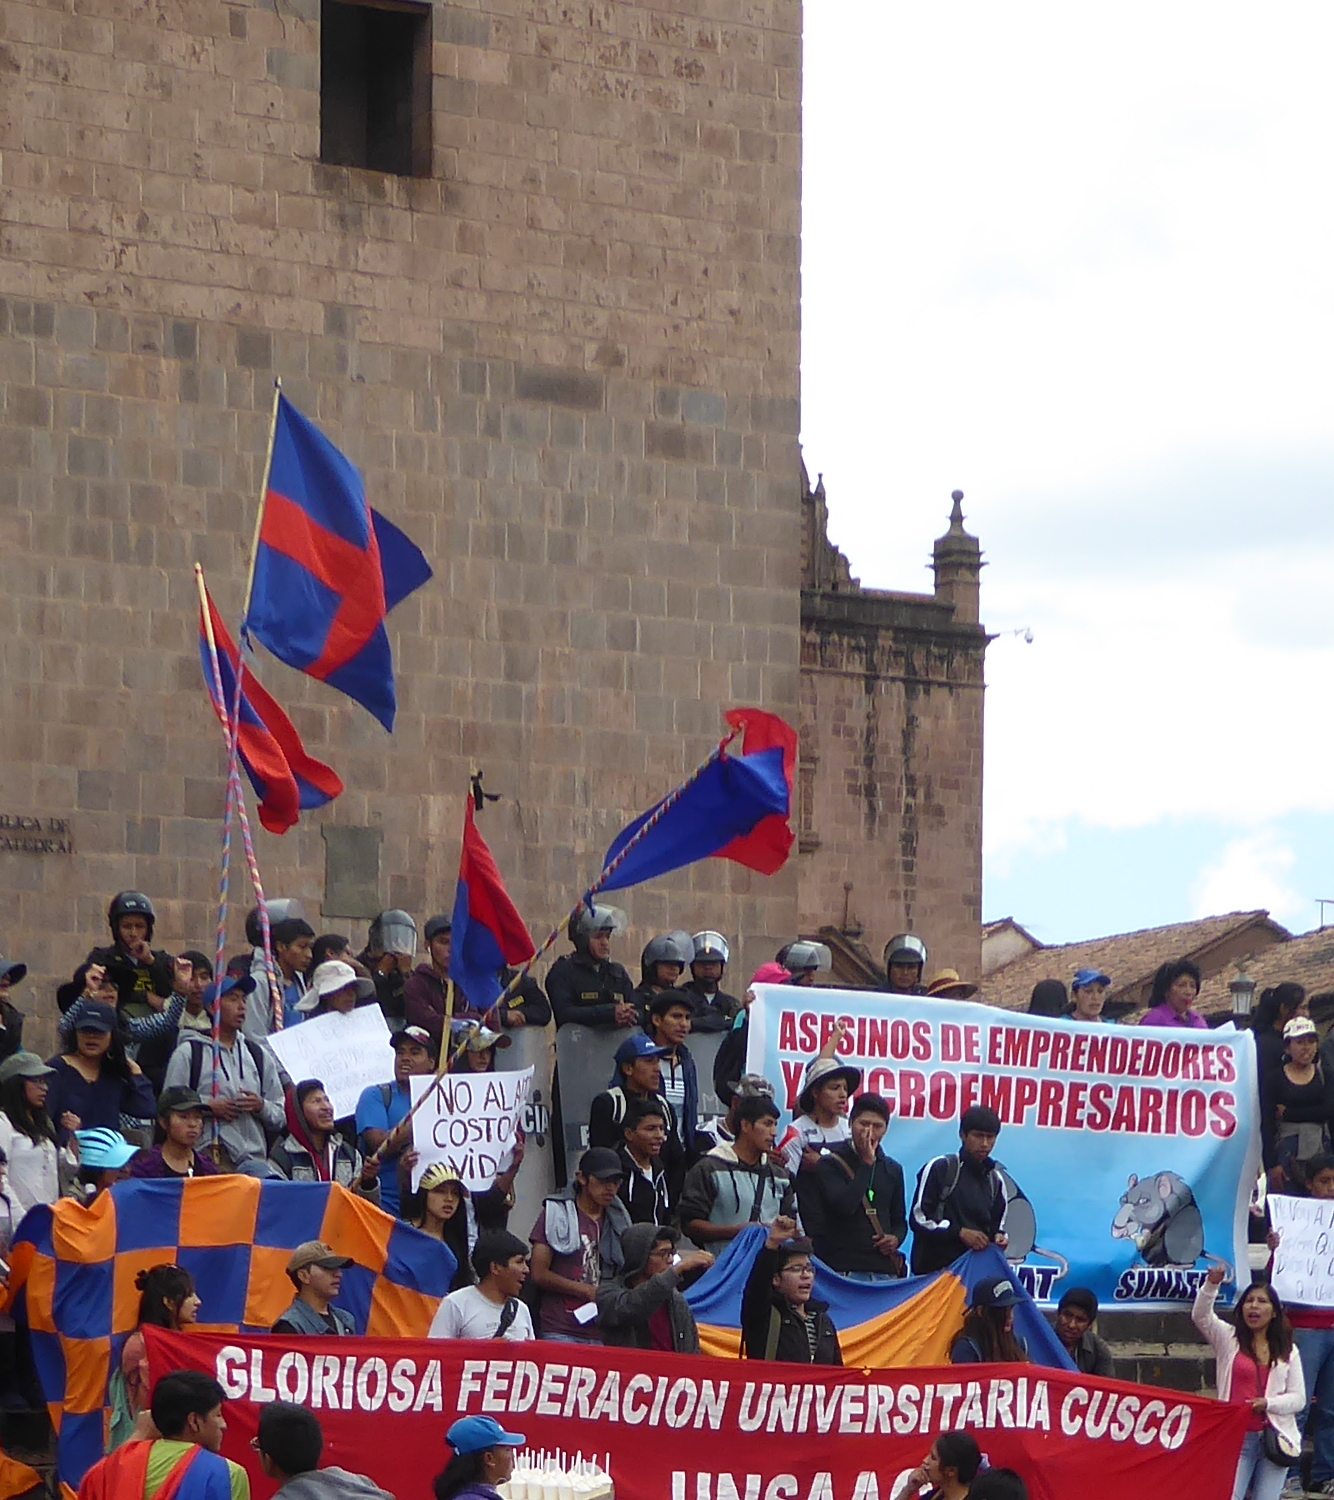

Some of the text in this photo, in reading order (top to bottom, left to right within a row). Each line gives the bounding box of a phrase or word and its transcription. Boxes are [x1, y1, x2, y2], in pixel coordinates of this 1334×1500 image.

[778, 1010, 1237, 1084] ASESINOS DE EMPRENDEDORES
[436, 1077, 472, 1115] NO
[483, 1081, 514, 1112] AL
[781, 1061, 806, 1110] Y
[433, 1115, 512, 1149] COSTO
[215, 1345, 1193, 1450] GLORIOSA FEDERACION UNIVERSITARIA CUSCO
